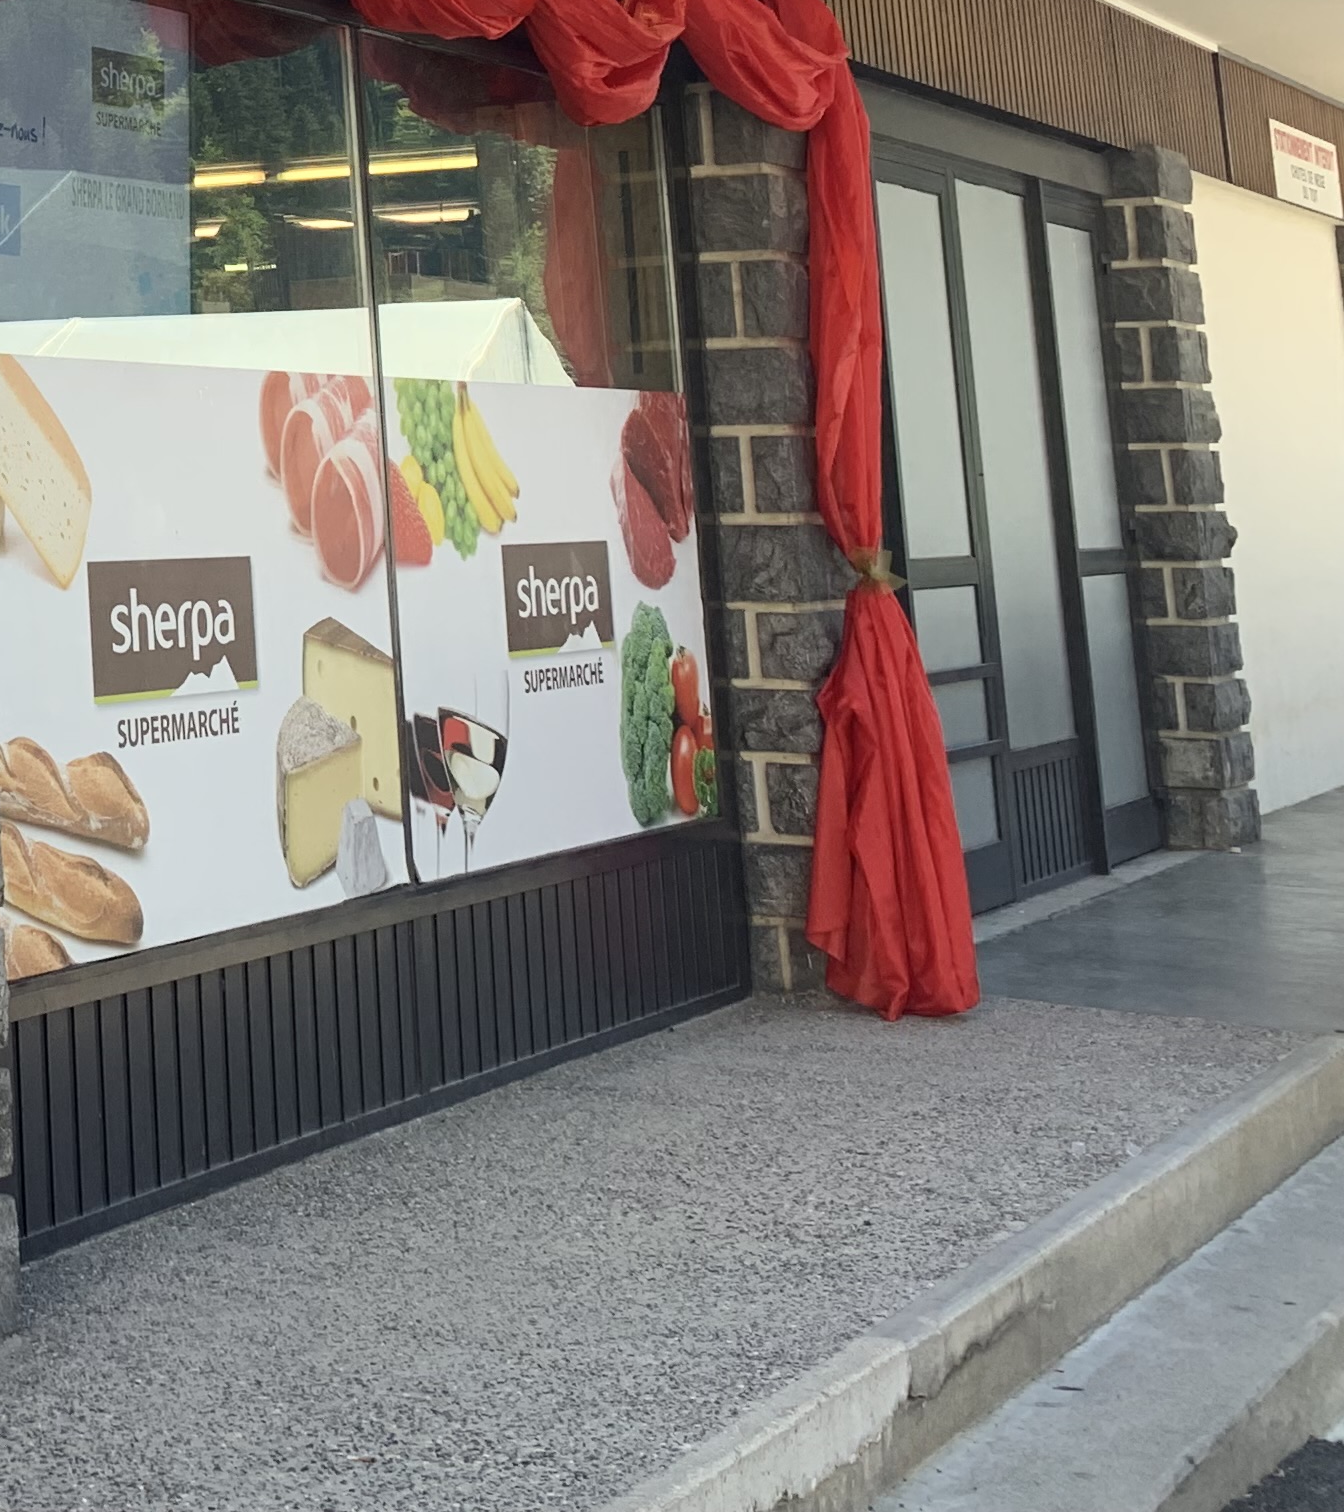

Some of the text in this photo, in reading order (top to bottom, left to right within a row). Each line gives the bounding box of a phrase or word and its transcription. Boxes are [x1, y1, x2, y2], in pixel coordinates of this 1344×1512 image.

[100, 61, 156, 99] sherpa
[71, 176, 104, 209] SHERPA
[115, 182, 144, 213] GRAND
[516, 565, 600, 625] sherpa
[109, 587, 237, 661] sherpa
[523, 659, 605, 694] SUPERMARCHÉ
[117, 703, 241, 749] SUPERMARCHÉ
